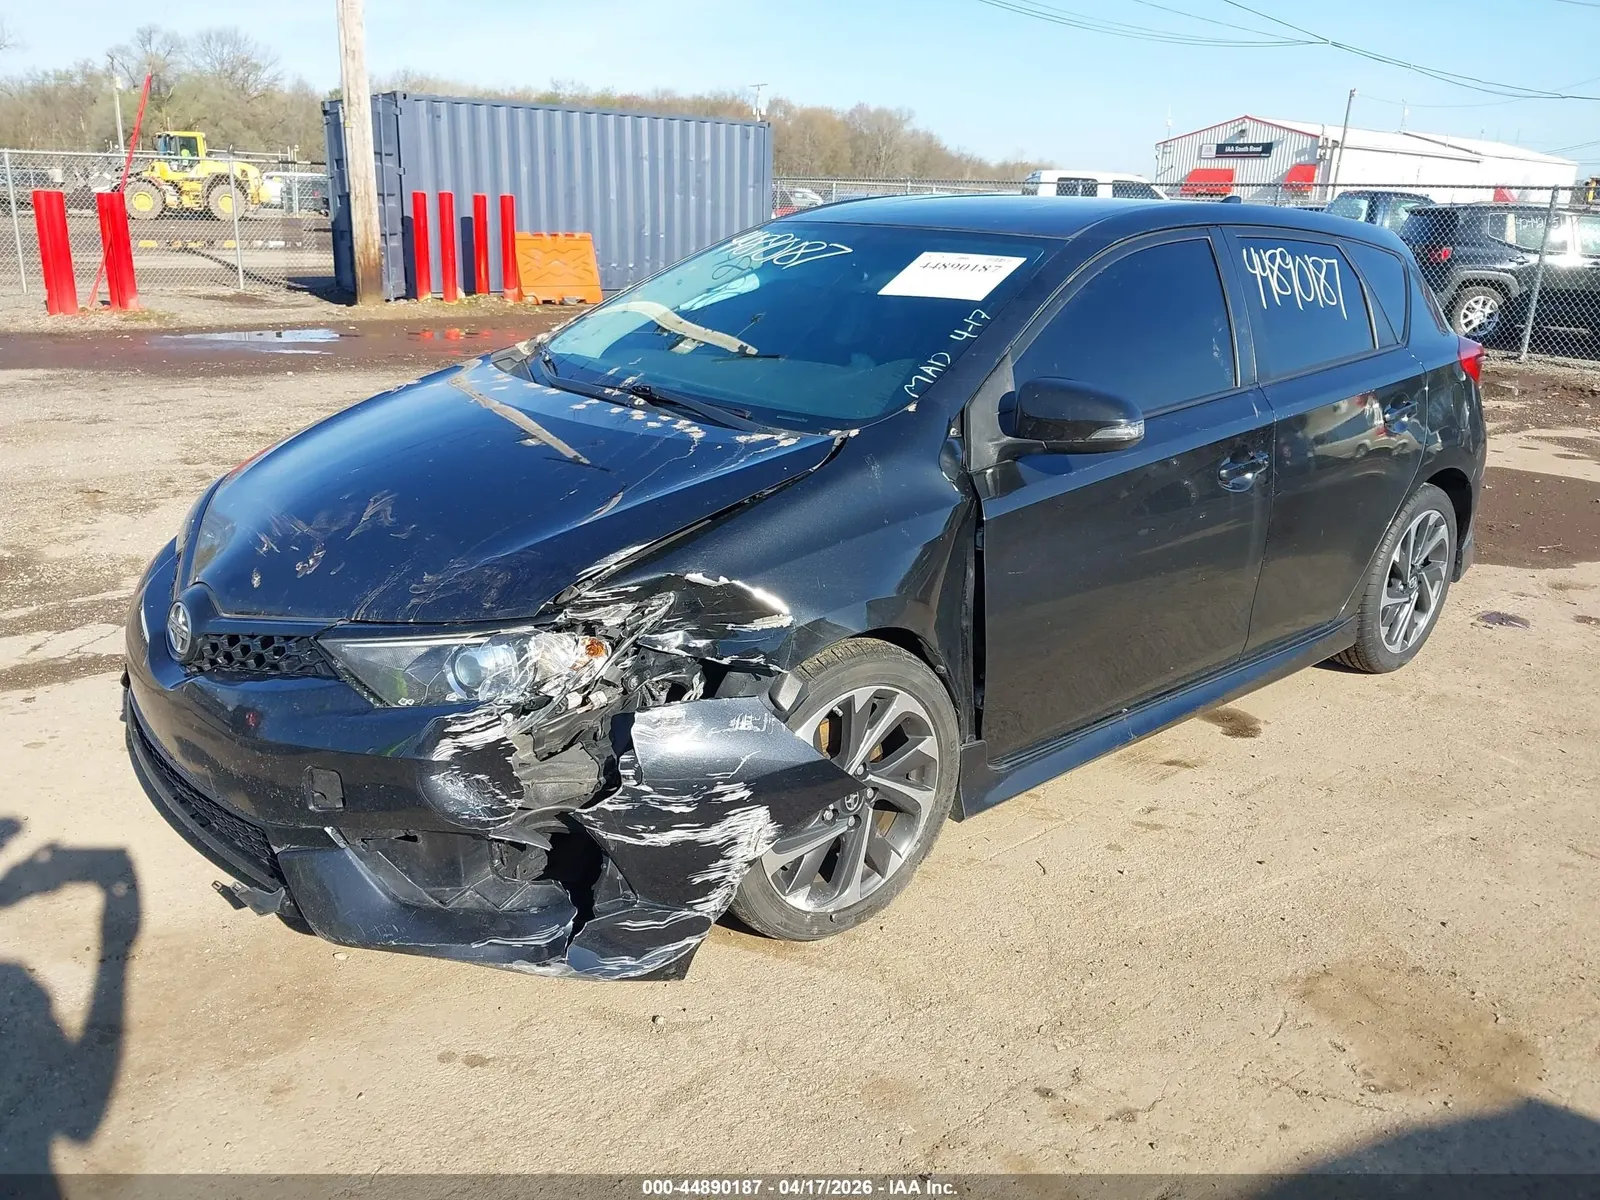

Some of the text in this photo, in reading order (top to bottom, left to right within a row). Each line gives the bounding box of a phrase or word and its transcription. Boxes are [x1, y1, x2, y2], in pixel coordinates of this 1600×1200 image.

[919, 261, 1003, 273] 44890187
[1243, 247, 1347, 320] 44890187
[904, 309, 991, 398] MAD 4-17
